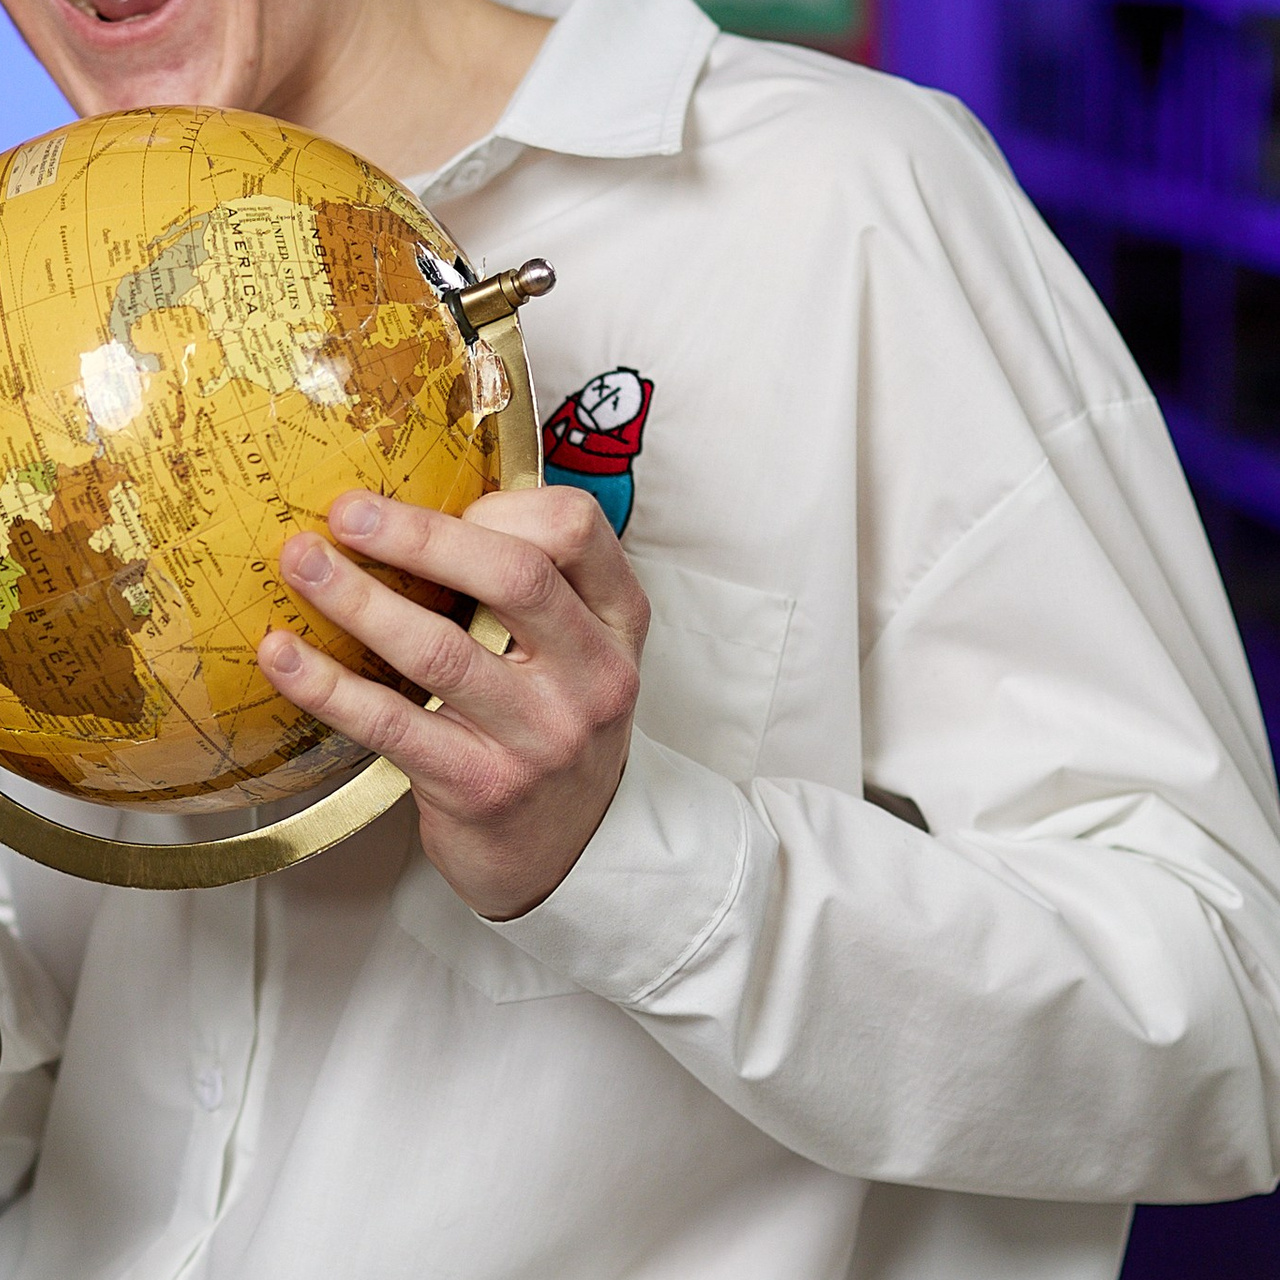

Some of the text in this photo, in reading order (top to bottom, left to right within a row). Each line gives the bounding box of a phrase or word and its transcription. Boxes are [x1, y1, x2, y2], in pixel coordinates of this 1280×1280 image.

[60, 225, 71, 264] Equatorial
[66, 268, 76, 299] Current
[149, 265, 166, 314] MEXICO
[225, 206, 260, 315] AMERICA
[271, 221, 299, 309] UNITED STATES
[309, 226, 338, 309] NORTH
[251, 353, 262, 373] Atlanta
[277, 340, 299, 385] Washington
[82, 466, 115, 524] COLOMBIA
[238, 431, 292, 524] NORTH
[11, 513, 57, 594] SOUTH
[251, 561, 313, 638] OCEAN
[34, 606, 82, 679] BRAZIL
